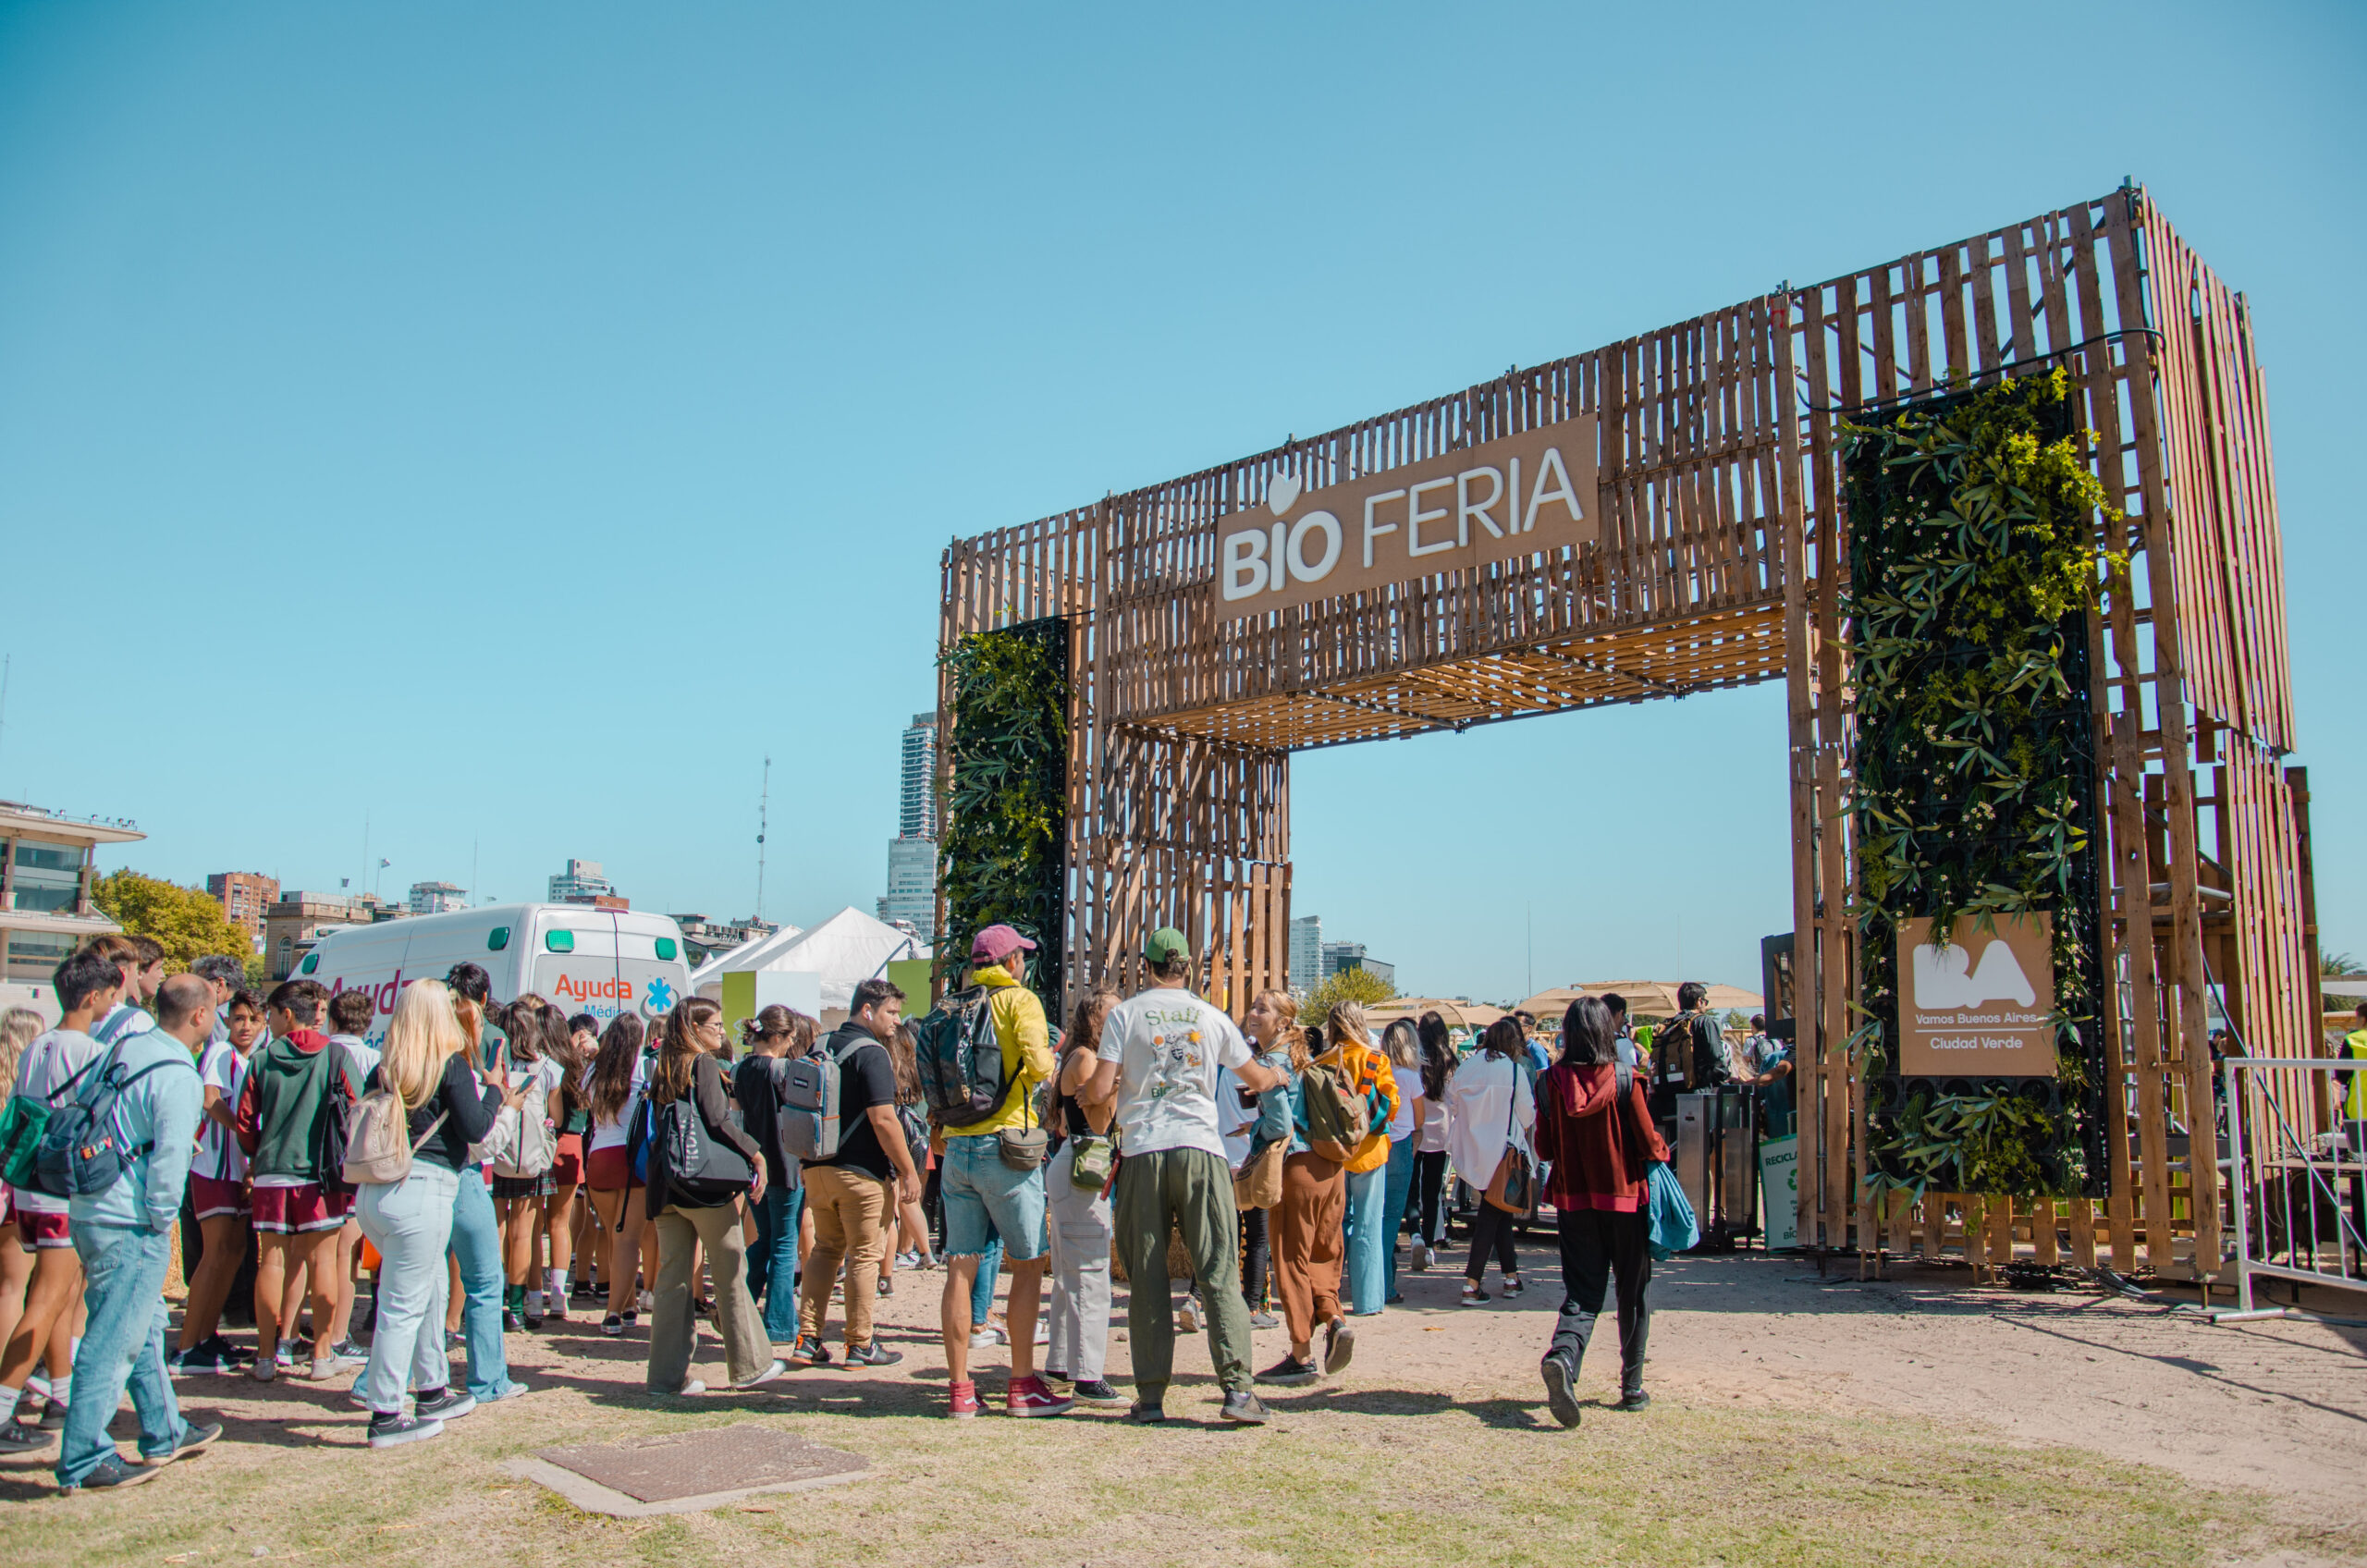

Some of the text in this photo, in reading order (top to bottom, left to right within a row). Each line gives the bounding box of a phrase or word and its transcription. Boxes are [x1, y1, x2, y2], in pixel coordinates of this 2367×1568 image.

[1222, 447, 1584, 602] BIO FERIA
[1913, 939, 2036, 1010] BA
[555, 974, 632, 1002] Ayuda
[1145, 1007, 1204, 1026] Staff
[1916, 1012, 2037, 1024] Vamos Buenos Aires
[1930, 1036, 2023, 1049] Ciudad Verde
